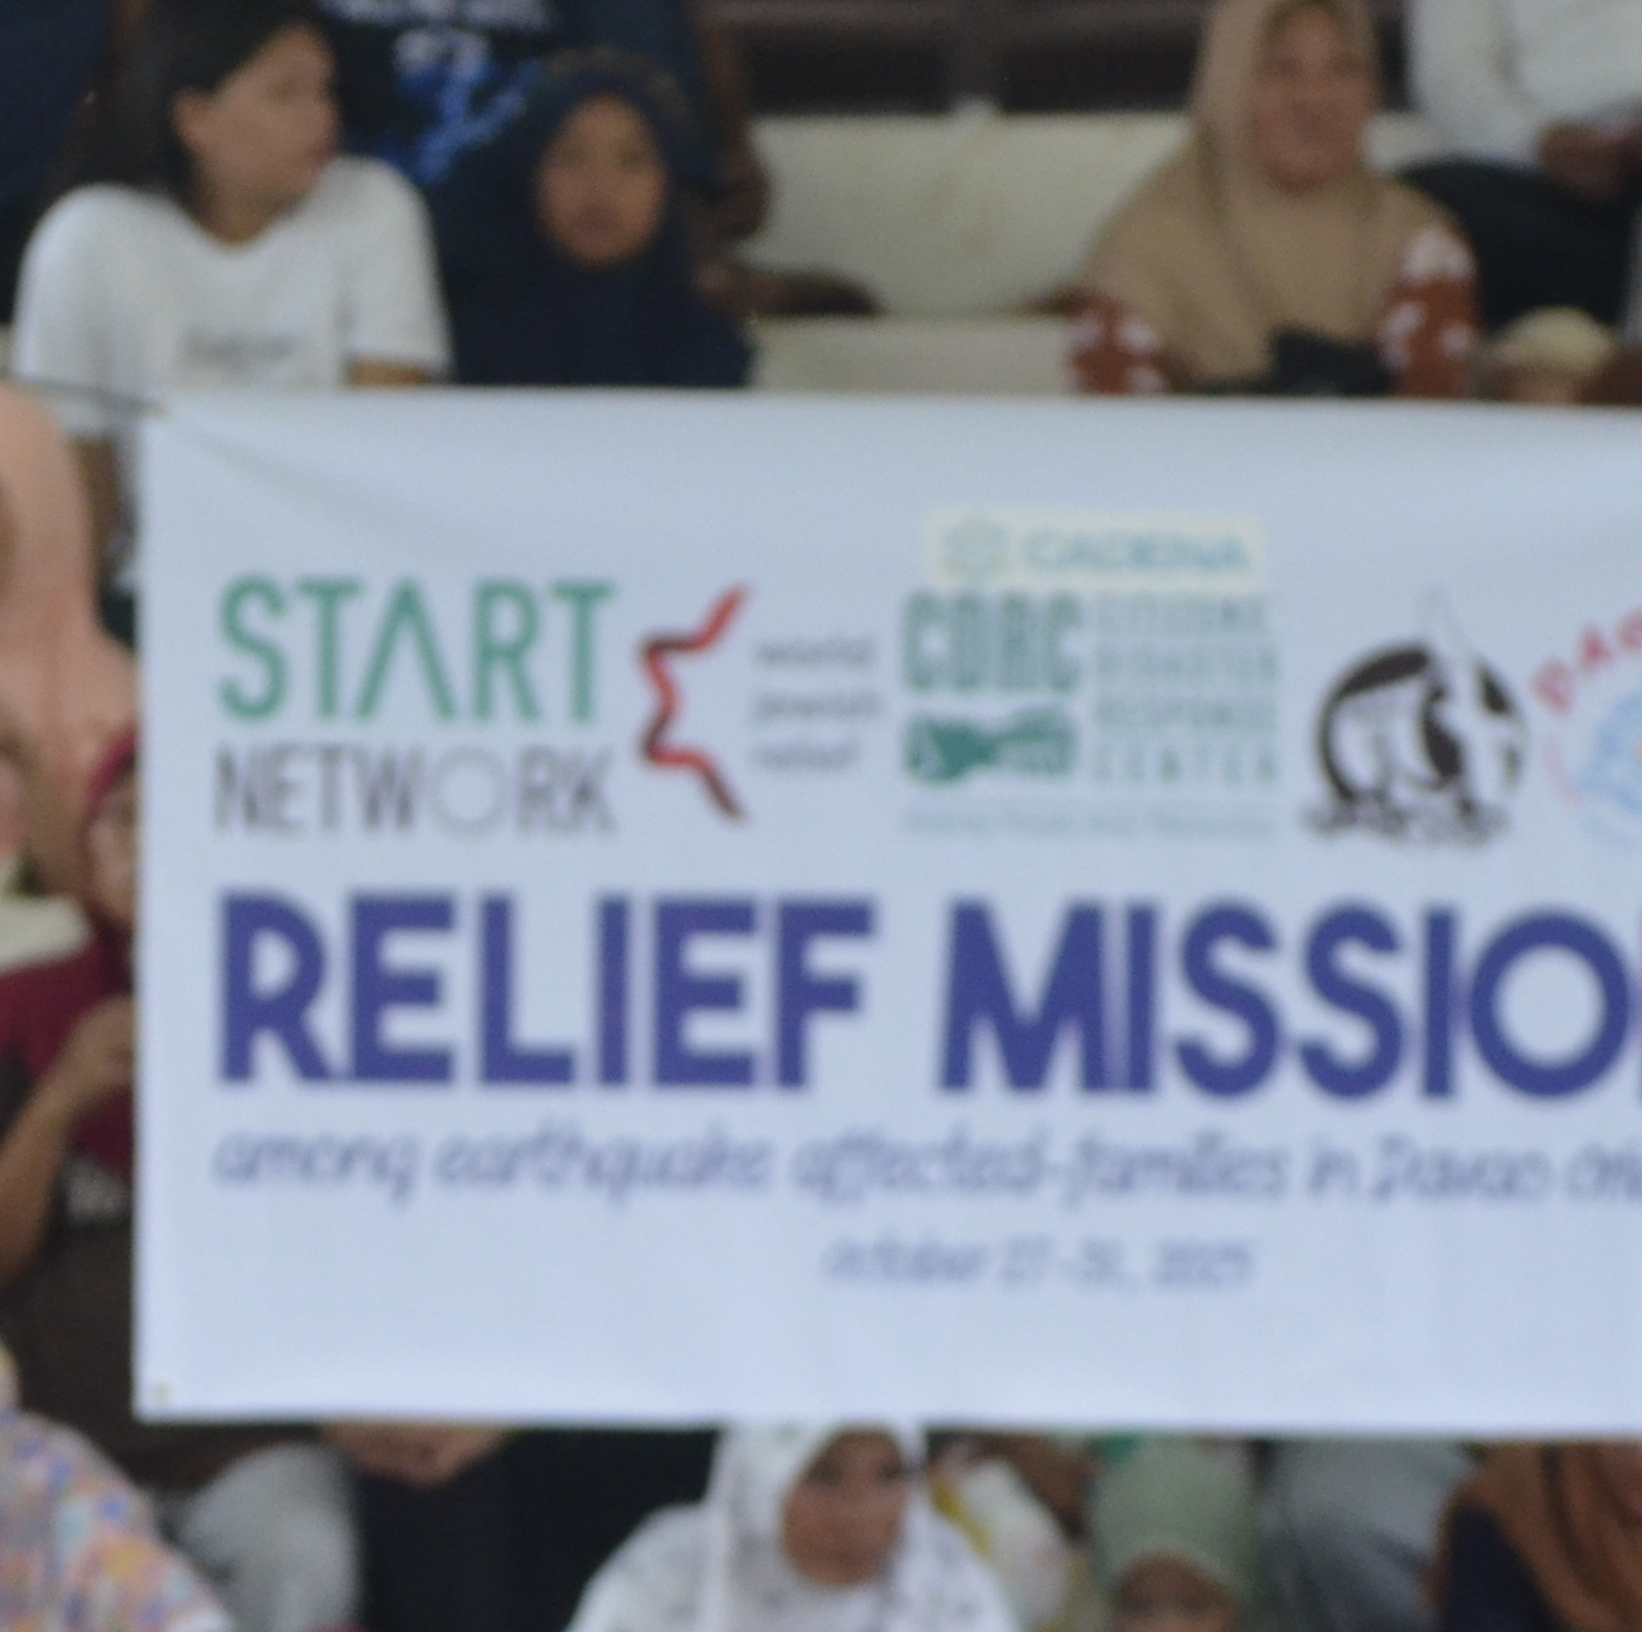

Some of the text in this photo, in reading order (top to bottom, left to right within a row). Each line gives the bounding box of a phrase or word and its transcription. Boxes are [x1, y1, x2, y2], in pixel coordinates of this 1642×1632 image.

[215, 573, 618, 725] START
[214, 742, 620, 837] NETWORK
[218, 889, 877, 1090] RELIEF
[215, 1132, 419, 1208] among
[434, 1118, 776, 1208] earthquake
[1304, 1138, 1357, 1199] in
[1370, 1136, 1549, 1204] Davao
